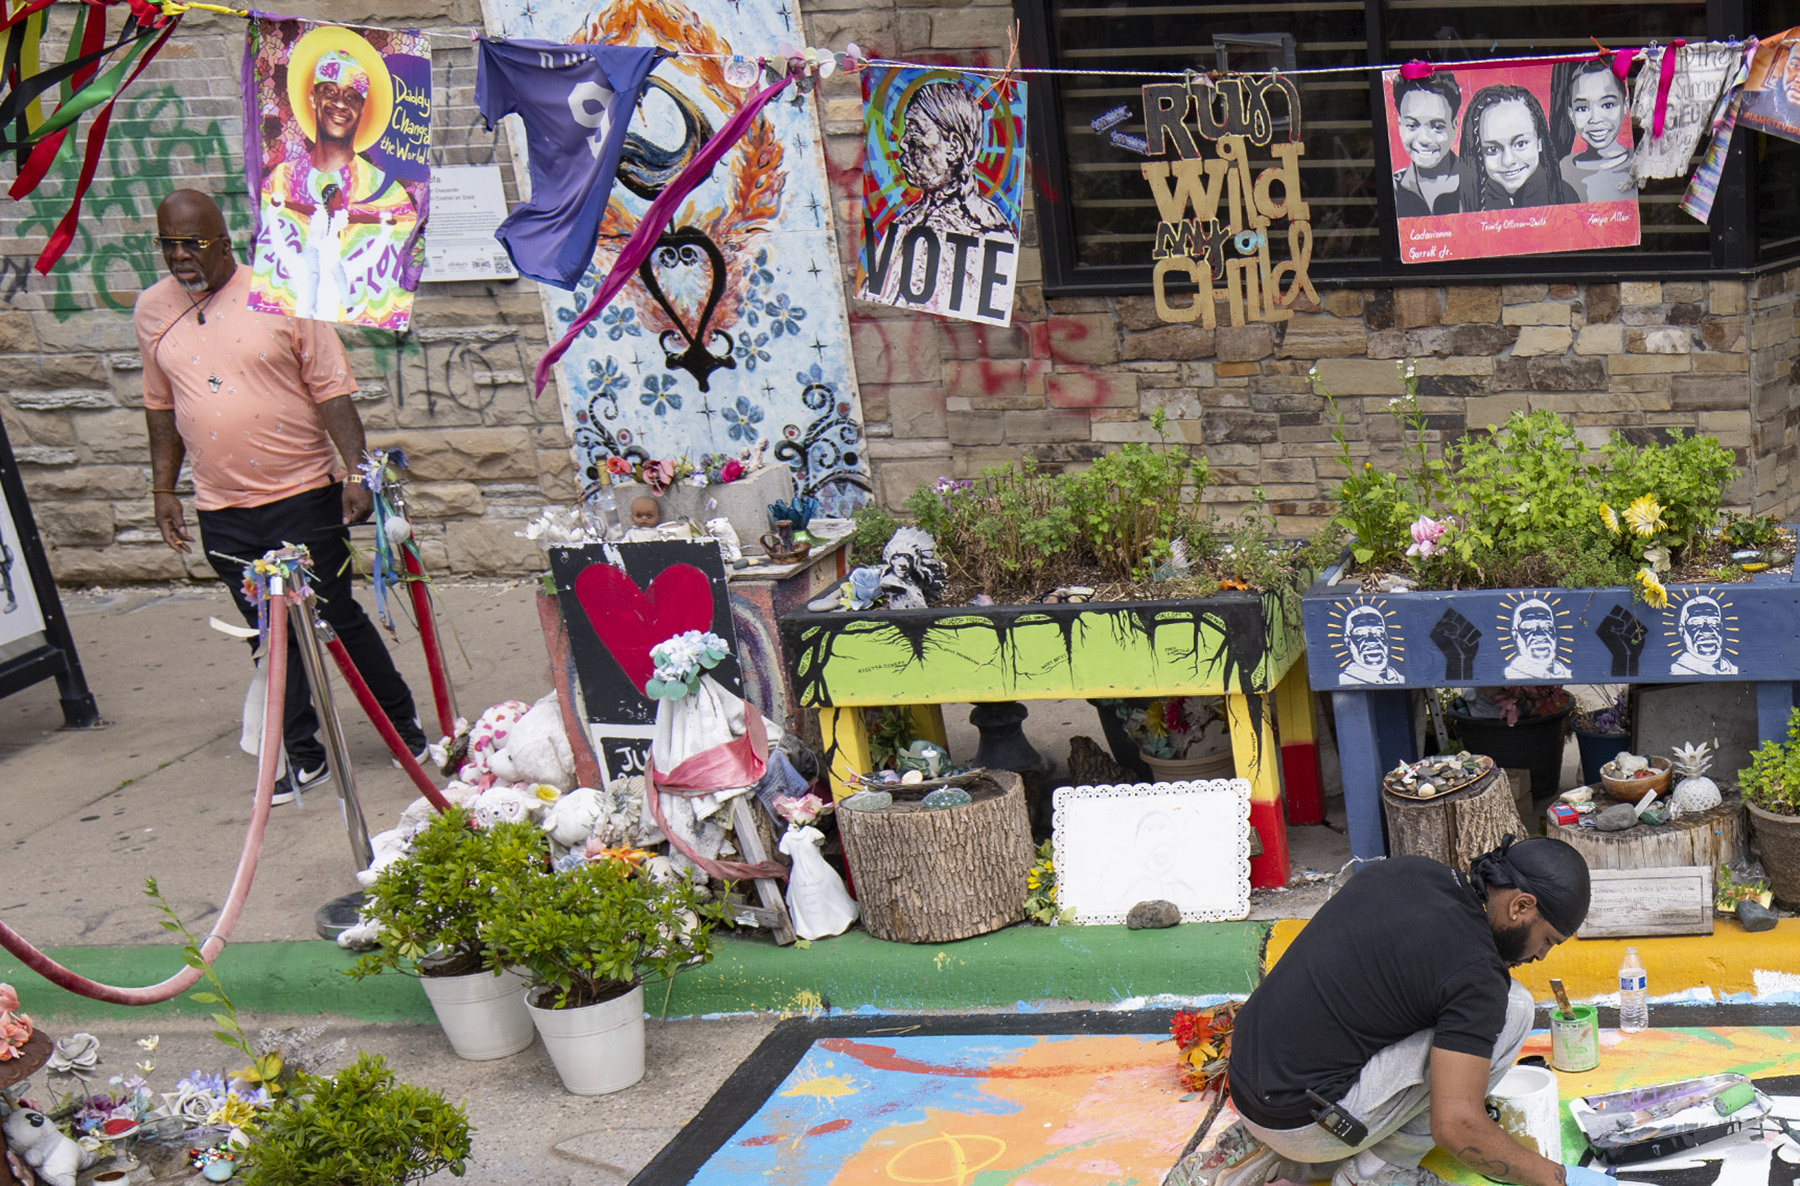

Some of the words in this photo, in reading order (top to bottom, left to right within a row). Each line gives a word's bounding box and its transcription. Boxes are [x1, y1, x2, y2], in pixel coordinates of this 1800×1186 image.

[392, 73, 430, 118] Daddy
[380, 136, 395, 155] the
[396, 137, 430, 166] World!
[1610, 211, 1630, 223] Allen
[1438, 246, 1453, 258] Jr.
[864, 216, 1016, 321] VOTE
